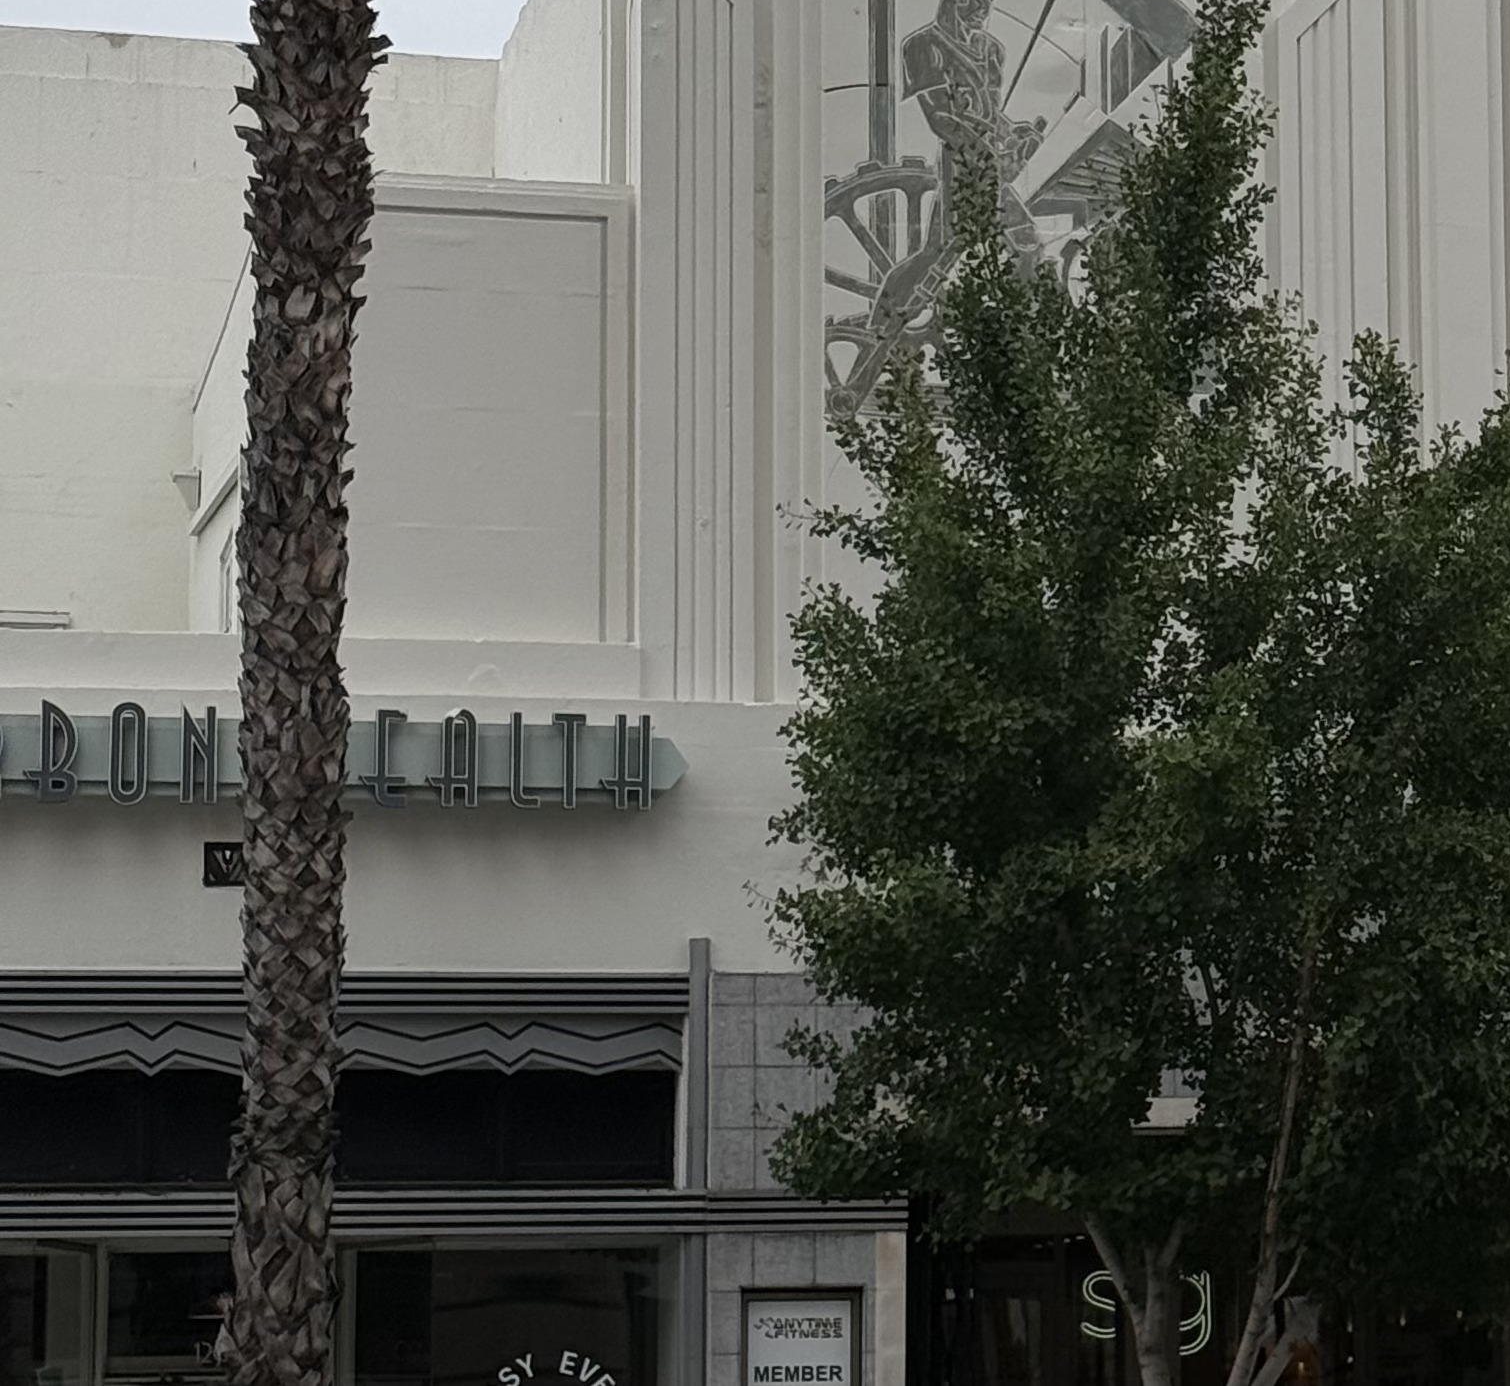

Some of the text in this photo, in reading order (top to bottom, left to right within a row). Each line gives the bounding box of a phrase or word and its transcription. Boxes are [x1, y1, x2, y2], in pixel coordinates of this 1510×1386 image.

[0, 699, 653, 810] BON EALTH
[774, 1317, 843, 1329] ANYTIME
[774, 1329, 843, 1339] FITNESS
[753, 1365, 843, 1383] MEMBER
